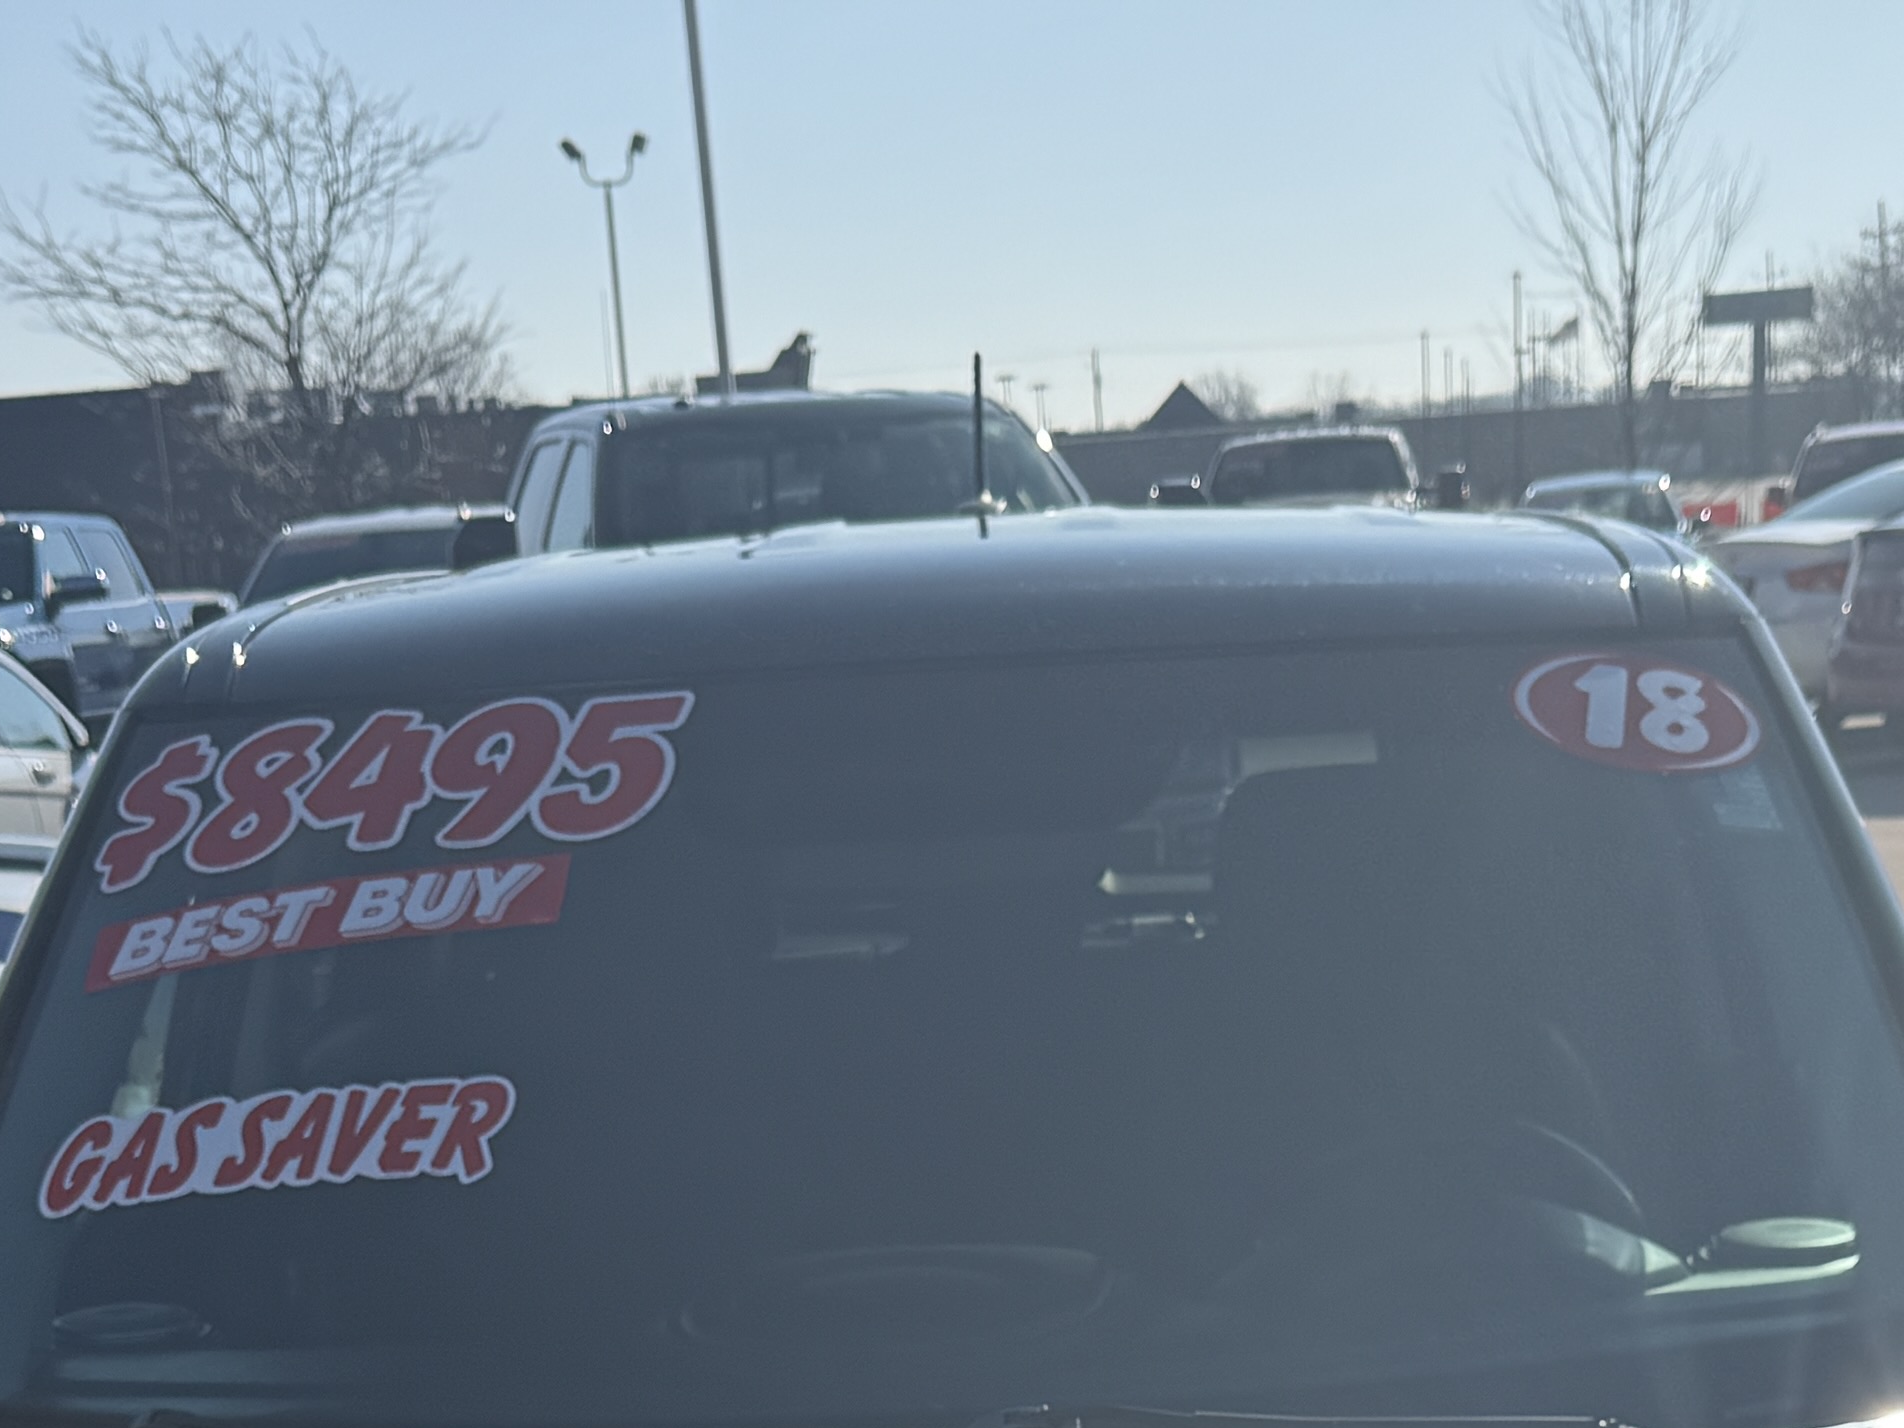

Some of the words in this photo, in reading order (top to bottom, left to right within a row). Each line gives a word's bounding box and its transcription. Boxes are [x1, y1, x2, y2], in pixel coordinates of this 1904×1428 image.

[1574, 664, 1710, 754] 18
[95, 692, 695, 894] $8495
[108, 886, 335, 981] BEST
[338, 863, 545, 940] BUY
[40, 1098, 230, 1218] GAS
[211, 1077, 516, 1191] SAVER
